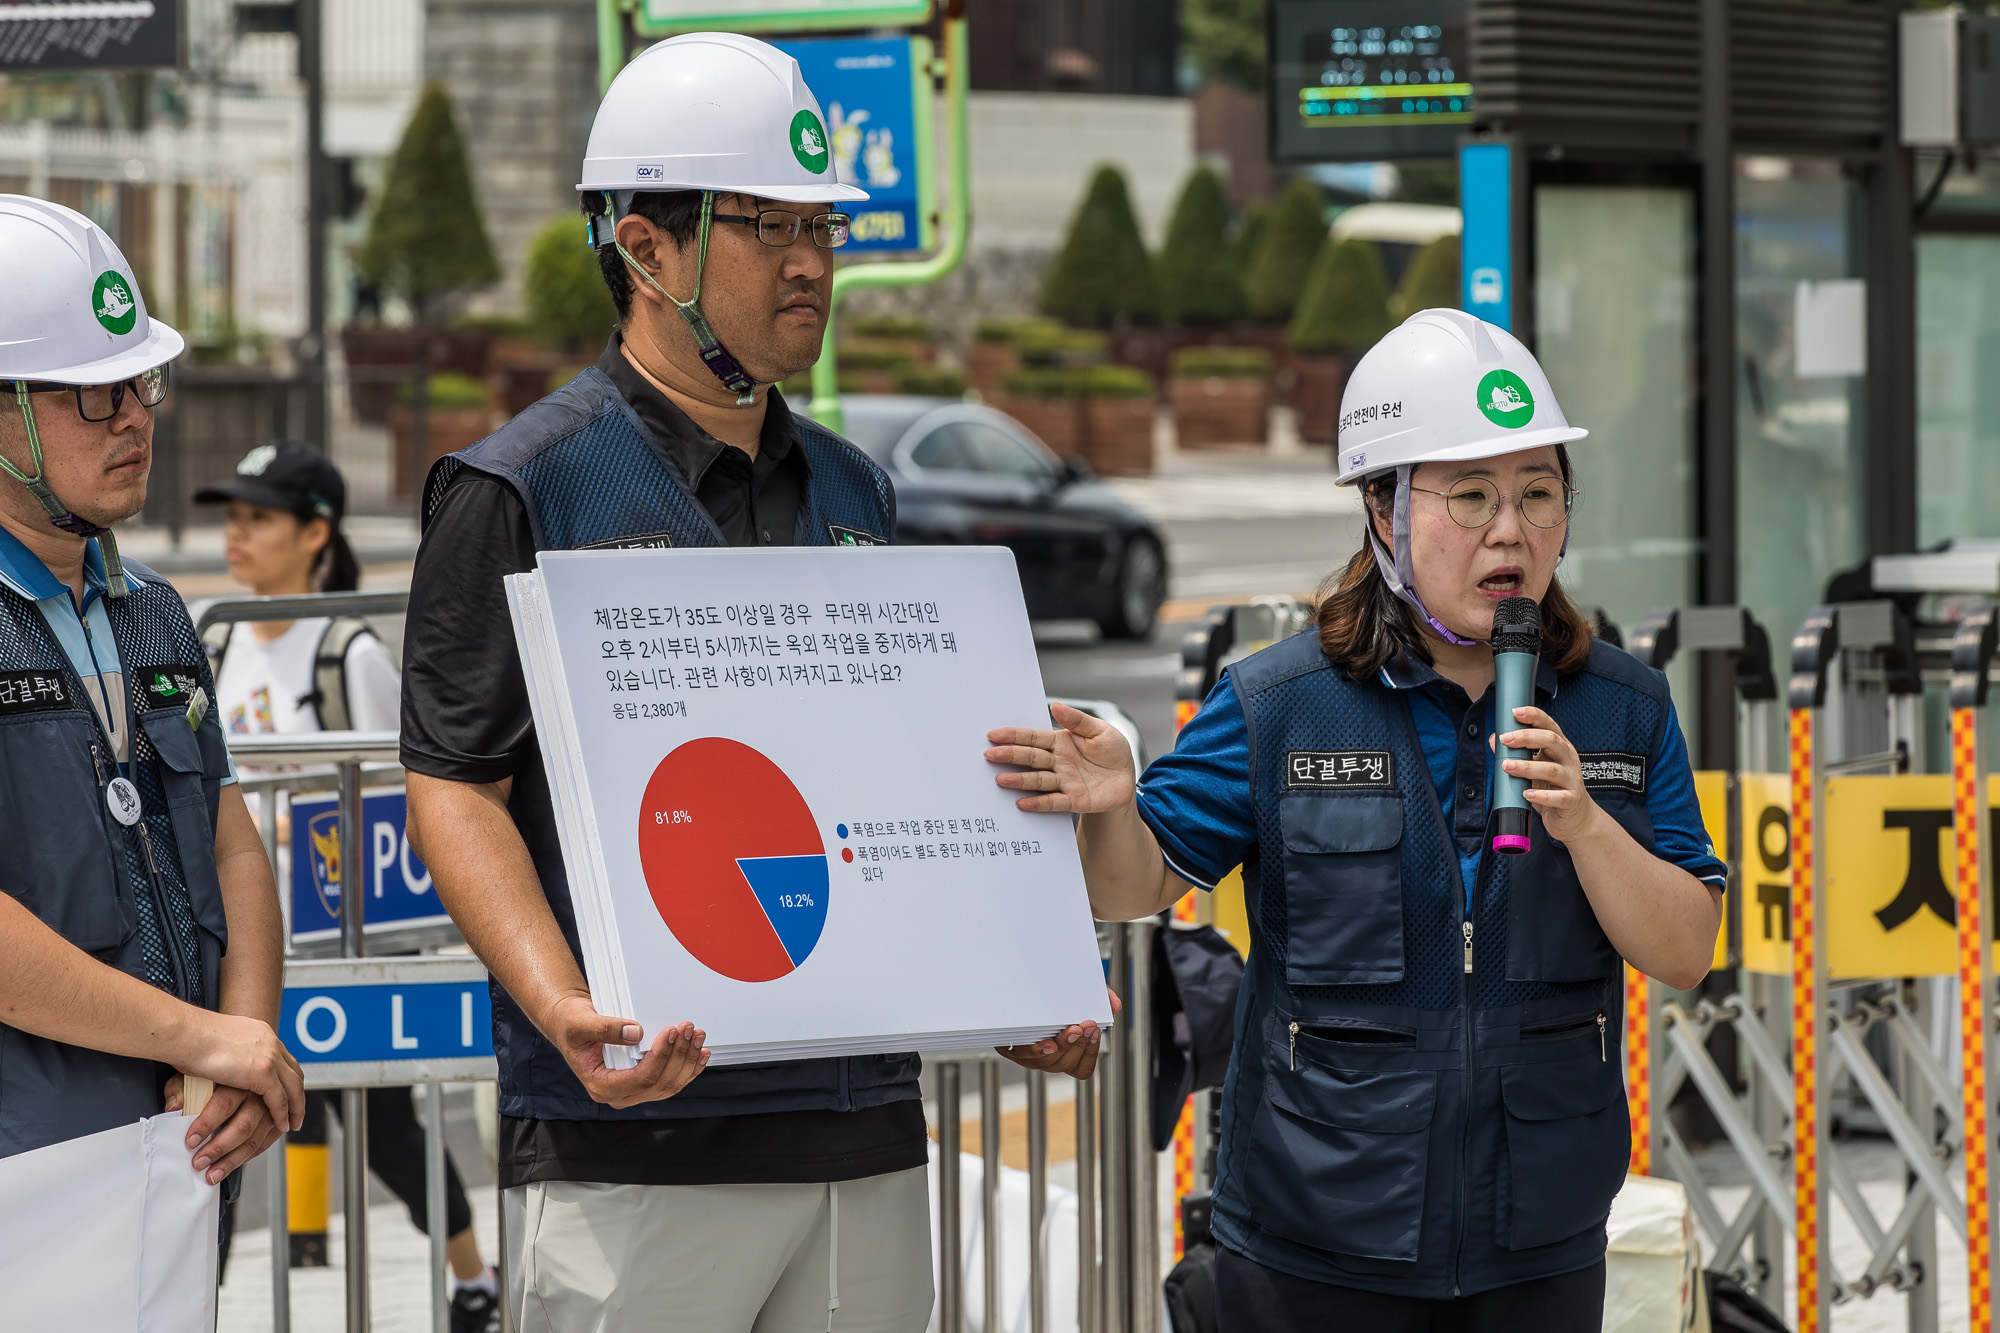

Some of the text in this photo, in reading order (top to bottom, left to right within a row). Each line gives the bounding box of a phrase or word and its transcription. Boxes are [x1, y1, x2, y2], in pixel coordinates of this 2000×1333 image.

[1353, 404, 1378, 426] 안전이
[1380, 400, 1402, 420] 우선
[594, 601, 940, 630] 체감온도가 35도 이상일 경우 무더위 시간대인
[601, 631, 958, 660] 오후 2시부터 5시까지는 옥외 작업을 중지하게 돼
[606, 662, 902, 692] 있습니다. 관련 사항이 지켜지고 있나요?
[612, 700, 688, 720] 응답 2,380개
[655, 810, 692, 825] 81.8%
[852, 817, 1000, 838] 폭염으로 작업 중단 된 적 있다.
[857, 840, 1042, 862] 폭염이어도 별도 중단 지시 없이 일하고
[861, 866, 884, 882] 있다
[779, 893, 814, 908] 18.2%
[295, 991, 473, 1054] OLI
